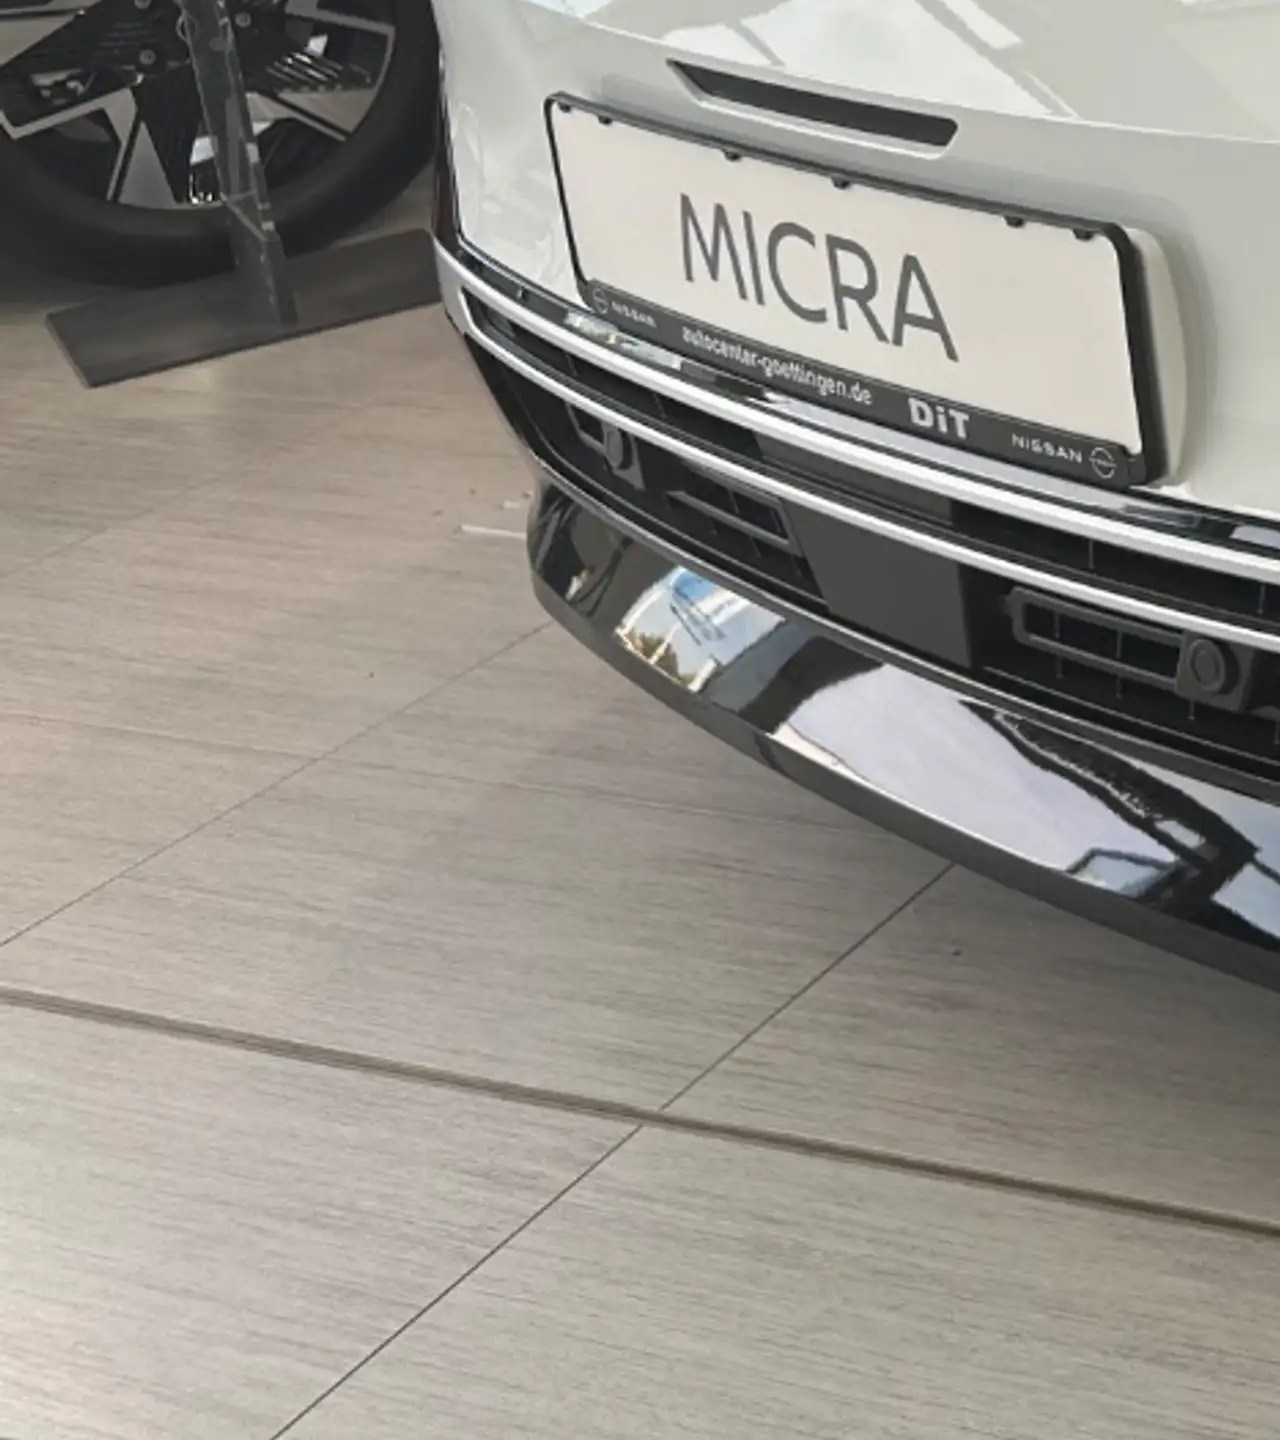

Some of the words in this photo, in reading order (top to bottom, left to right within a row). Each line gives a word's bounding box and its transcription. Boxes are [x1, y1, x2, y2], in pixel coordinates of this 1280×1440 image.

[680, 192, 960, 363] MICRA
[682, 325, 873, 406] autocenter-goettingen.de
[1011, 432, 1083, 465] NISSAN
